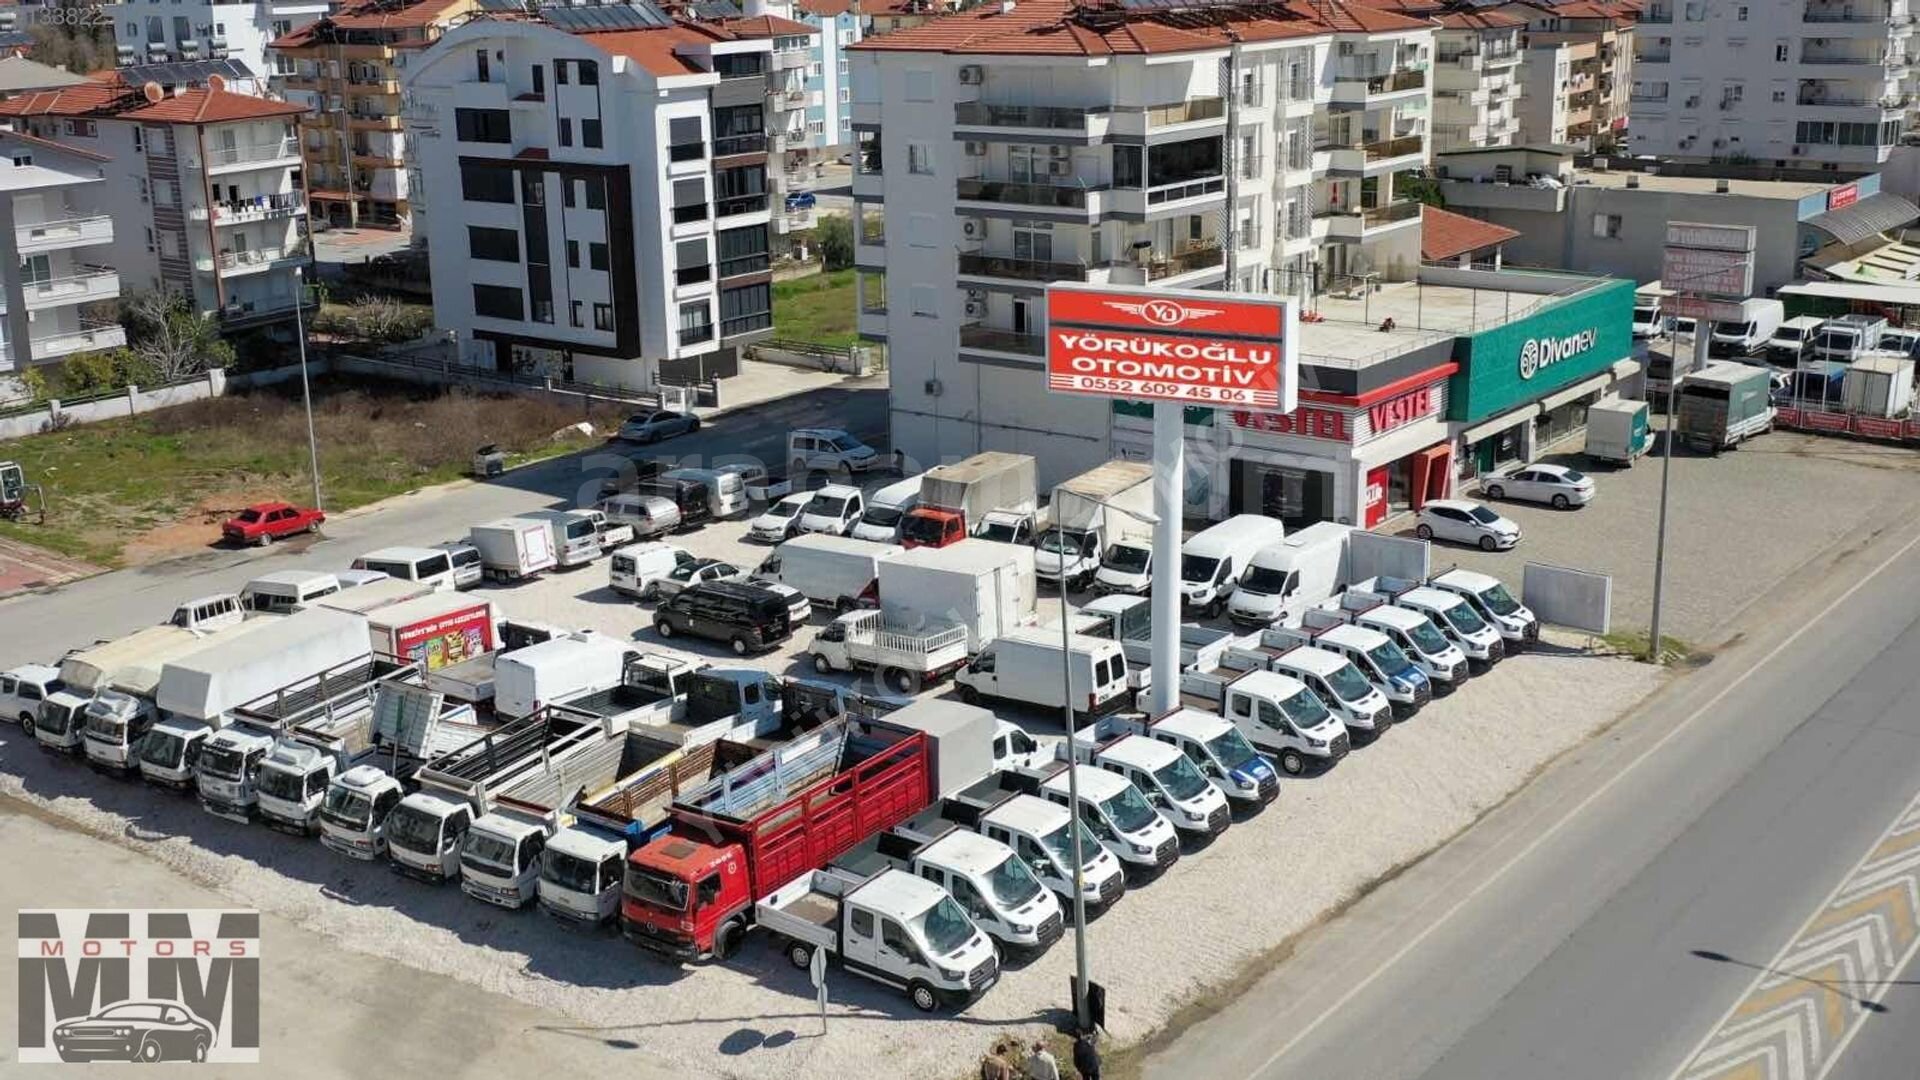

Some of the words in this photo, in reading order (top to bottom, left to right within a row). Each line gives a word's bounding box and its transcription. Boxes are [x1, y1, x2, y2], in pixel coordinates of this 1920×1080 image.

[1058, 332, 1272, 364] YÖRÜKOĞLU
[1538, 326, 1598, 369] Divanev
[1071, 356, 1256, 385] OTOMOTİV
[1081, 376, 1134, 393] 0552
[1140, 381, 1179, 396] 609
[1185, 385, 1212, 400] 45
[1219, 388, 1246, 402] 06
[1232, 406, 1346, 441] VESTEL
[1368, 386, 1434, 435] VESTEL
